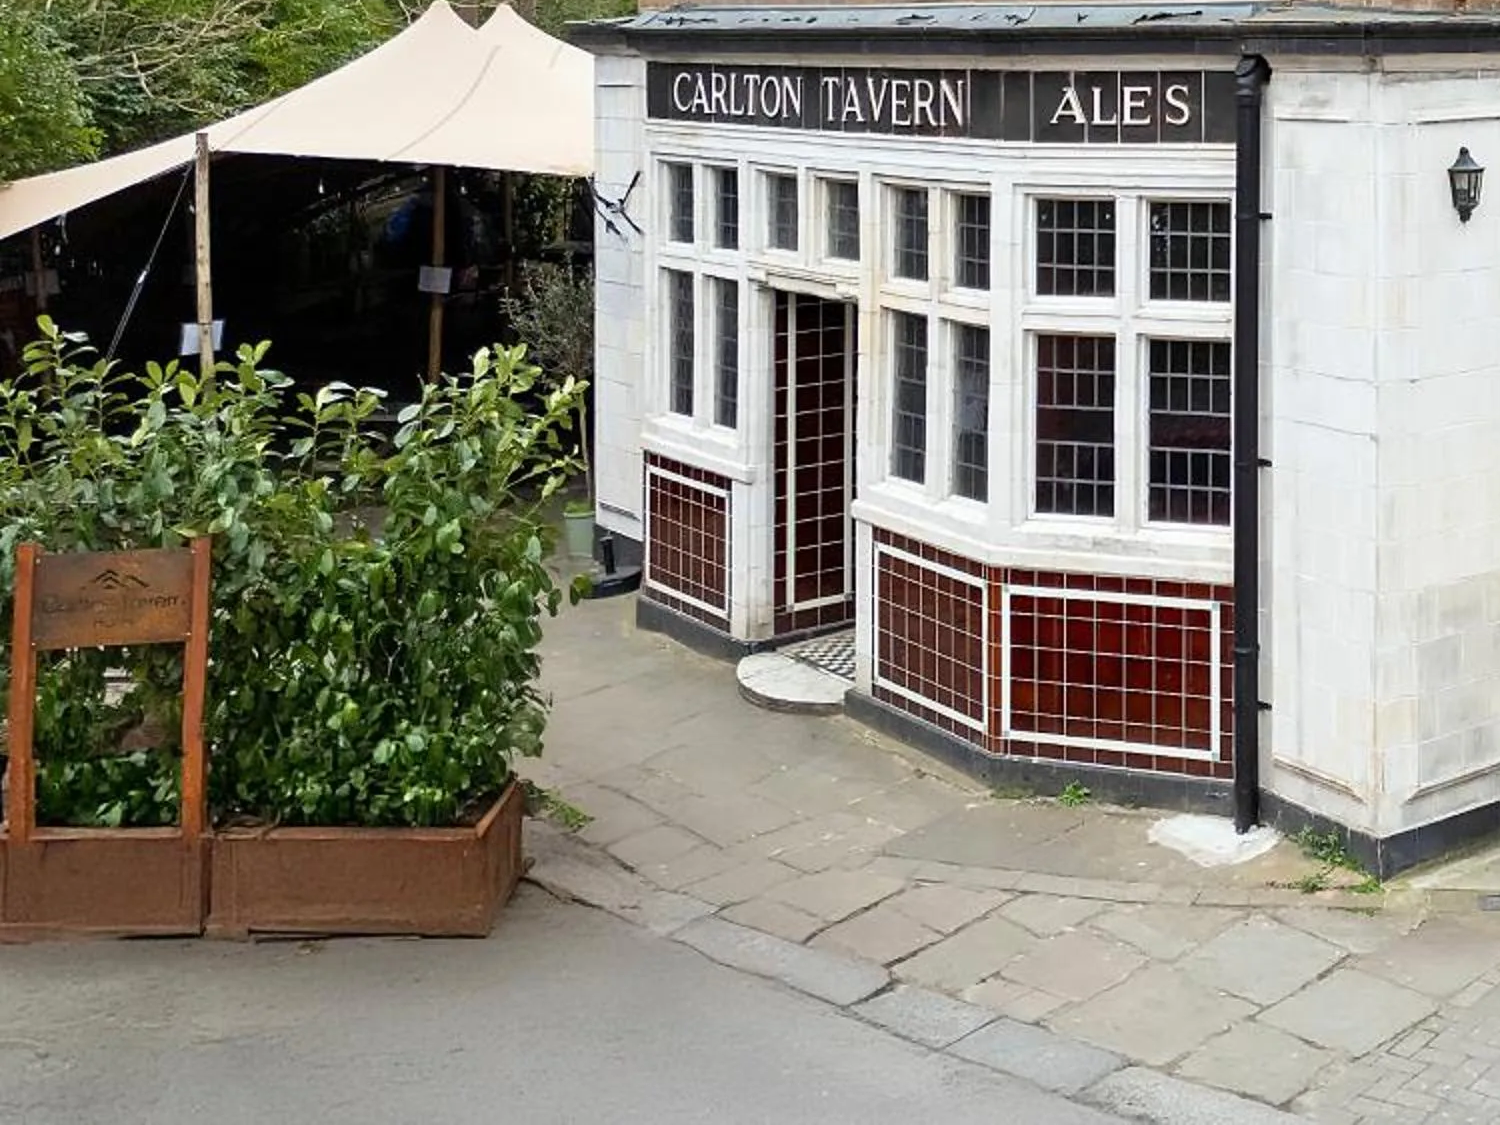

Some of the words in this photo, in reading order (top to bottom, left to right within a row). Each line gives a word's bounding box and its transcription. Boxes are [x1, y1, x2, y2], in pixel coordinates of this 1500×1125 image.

[673, 72, 803, 118] CARLTON
[820, 77, 965, 127] TAVERN
[1049, 85, 1192, 126] ALES
